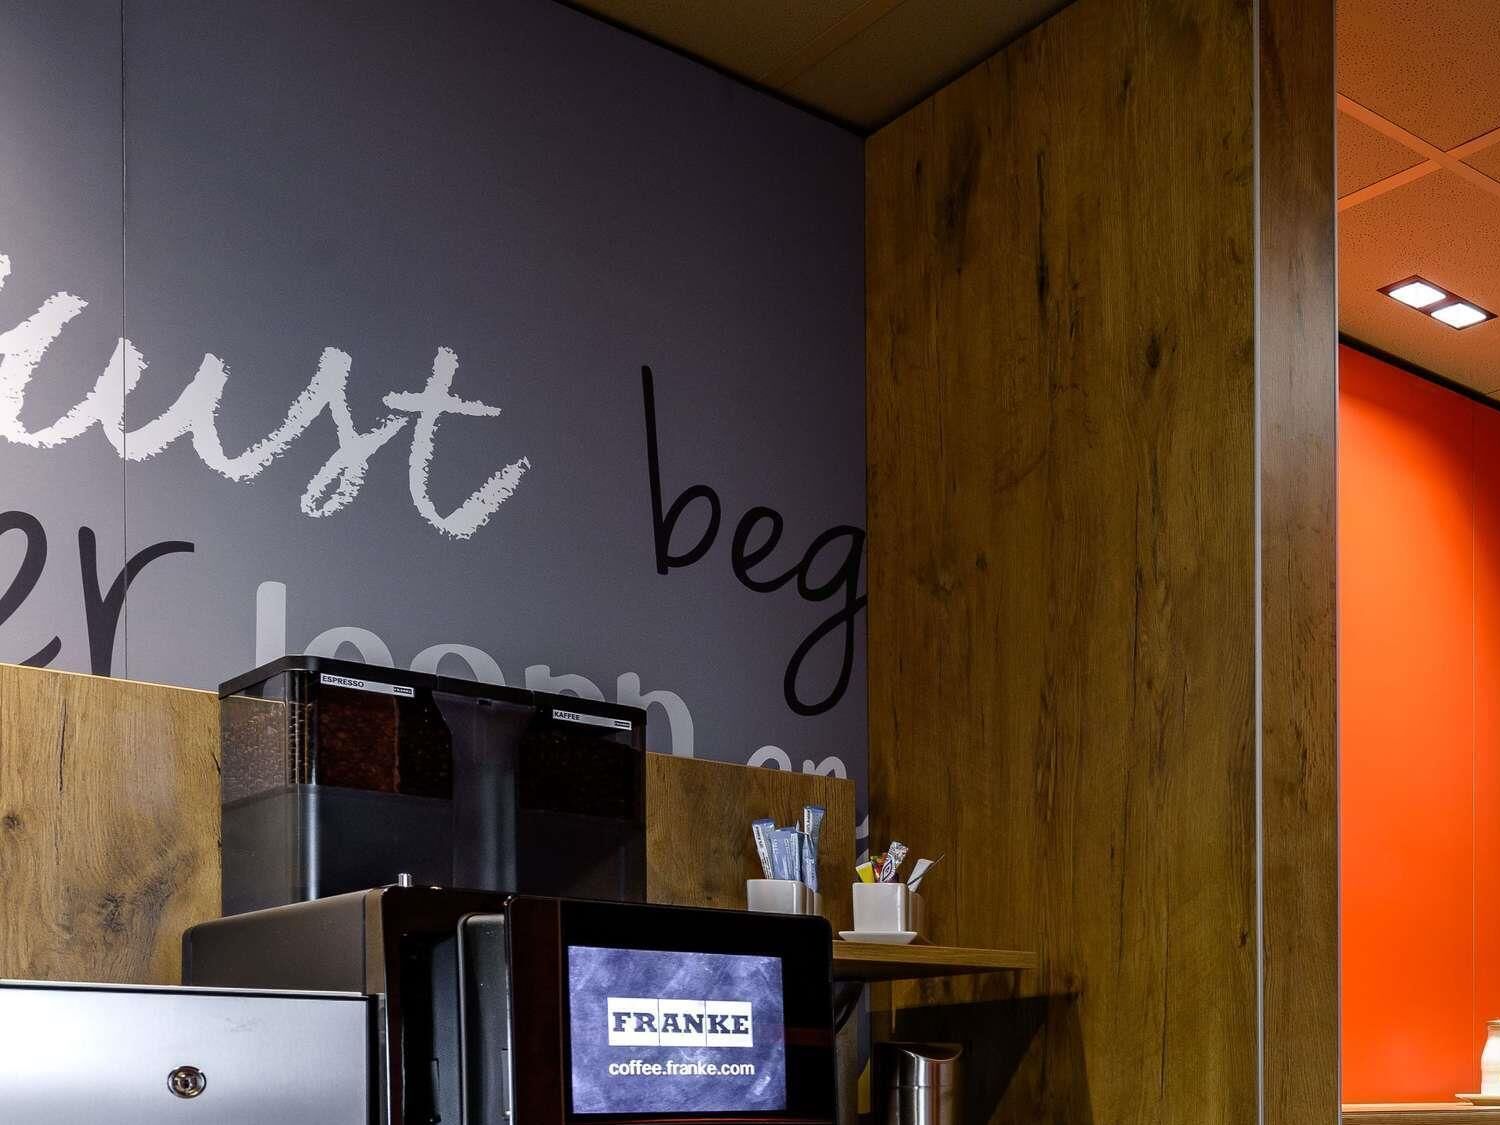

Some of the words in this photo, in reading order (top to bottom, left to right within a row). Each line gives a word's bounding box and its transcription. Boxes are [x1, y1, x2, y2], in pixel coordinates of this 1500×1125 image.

[322, 674, 365, 688] ESPRESSO
[553, 710, 581, 721] KAFFEE
[612, 1011, 750, 1035] FRANKE
[608, 1059, 756, 1076] coffee.franke.com
